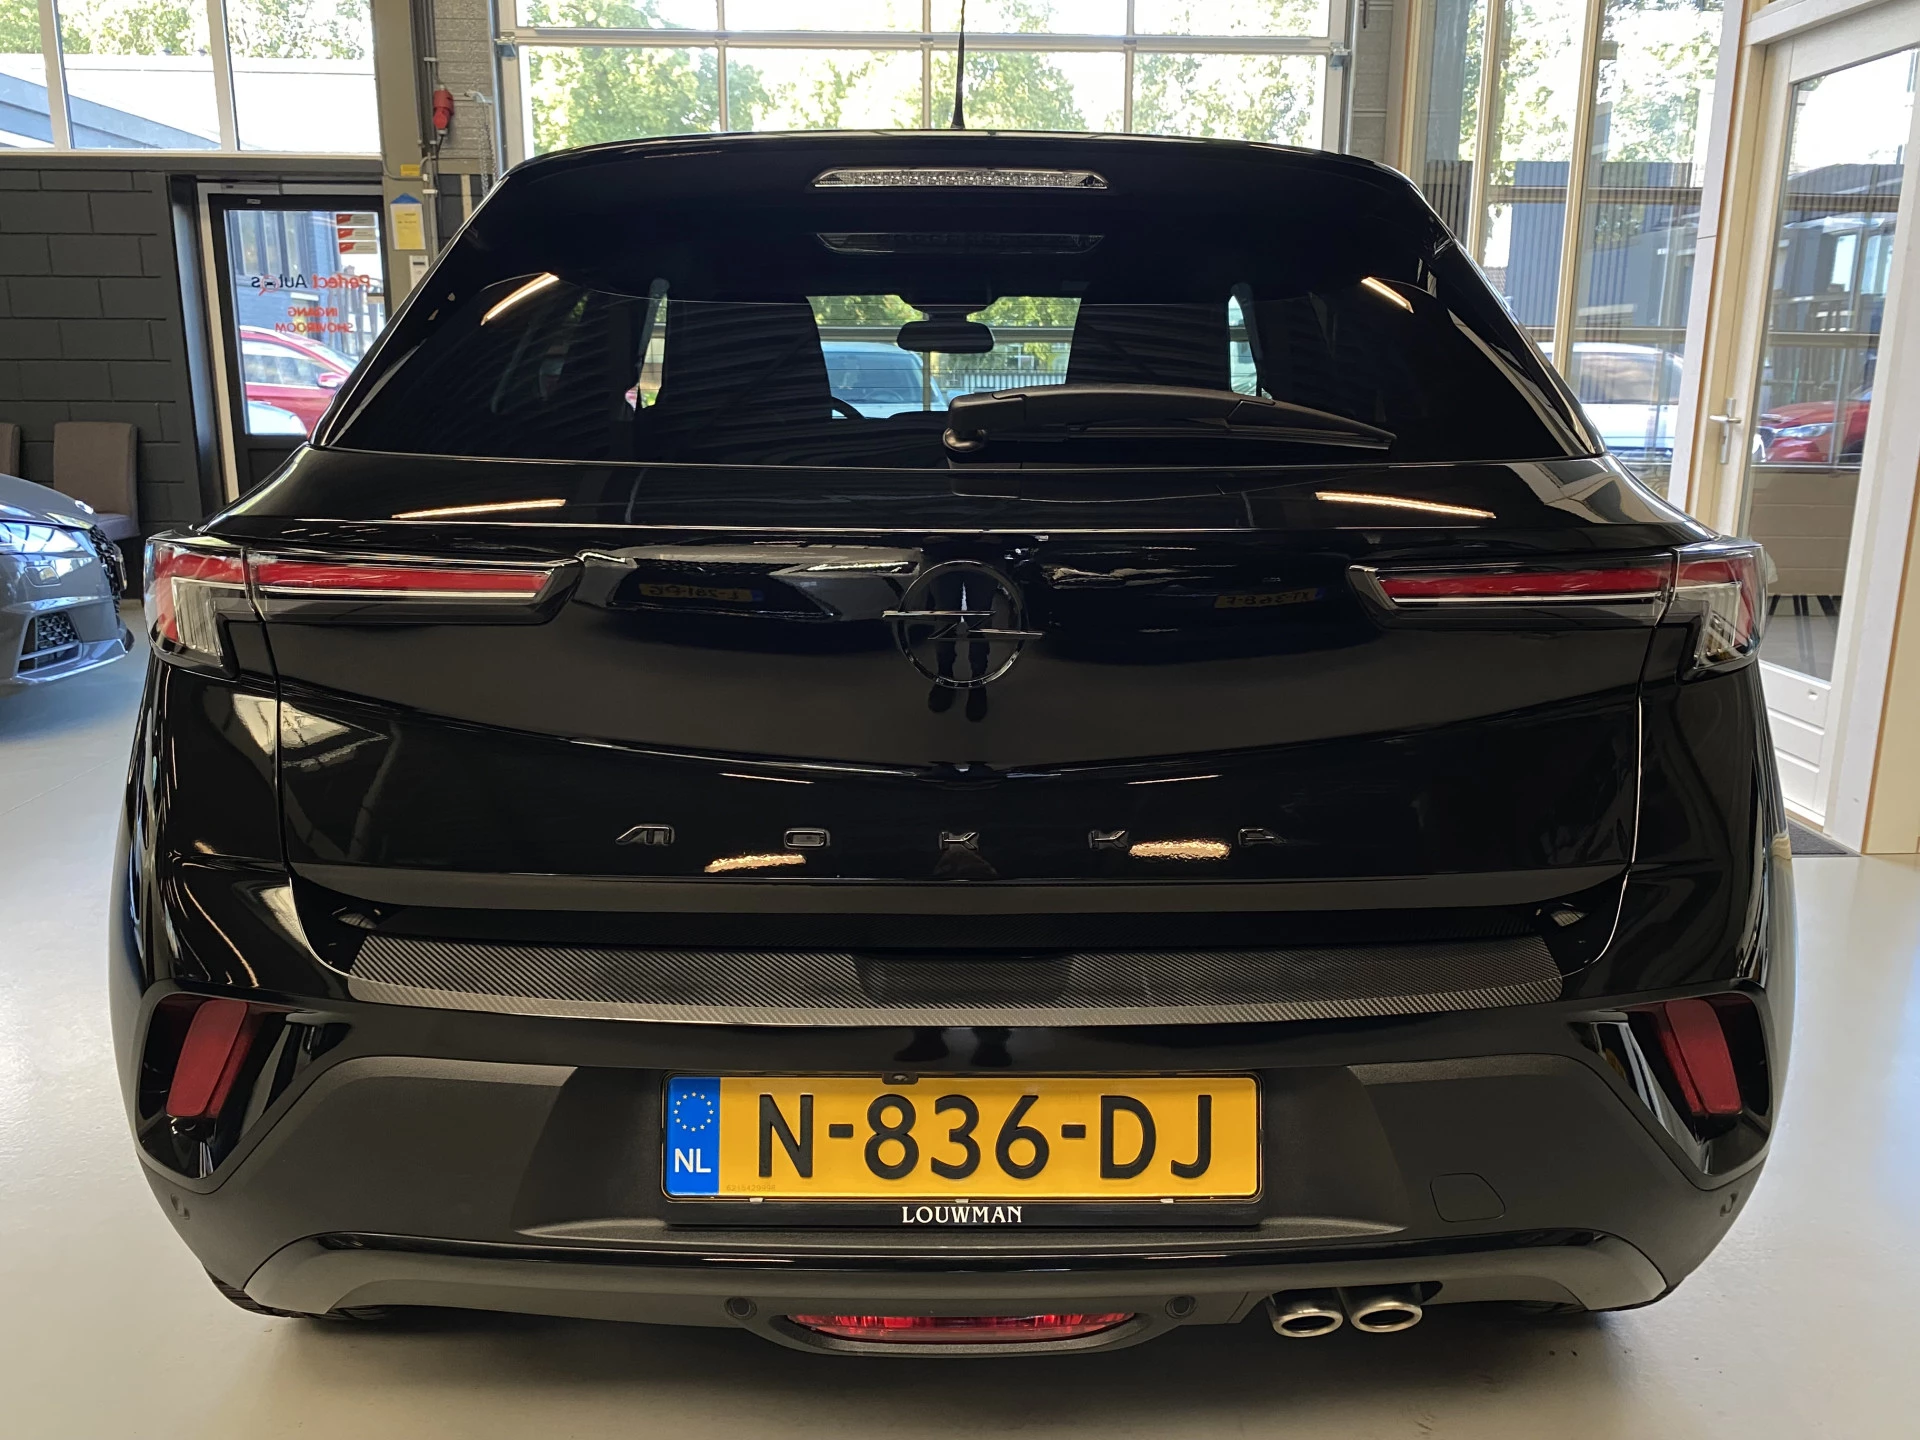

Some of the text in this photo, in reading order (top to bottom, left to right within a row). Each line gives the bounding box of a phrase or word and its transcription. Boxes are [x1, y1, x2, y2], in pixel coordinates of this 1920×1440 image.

[674, 1093, 1212, 1180] NL N-836-DJ
[902, 1206, 1022, 1223] LOUWMAN
